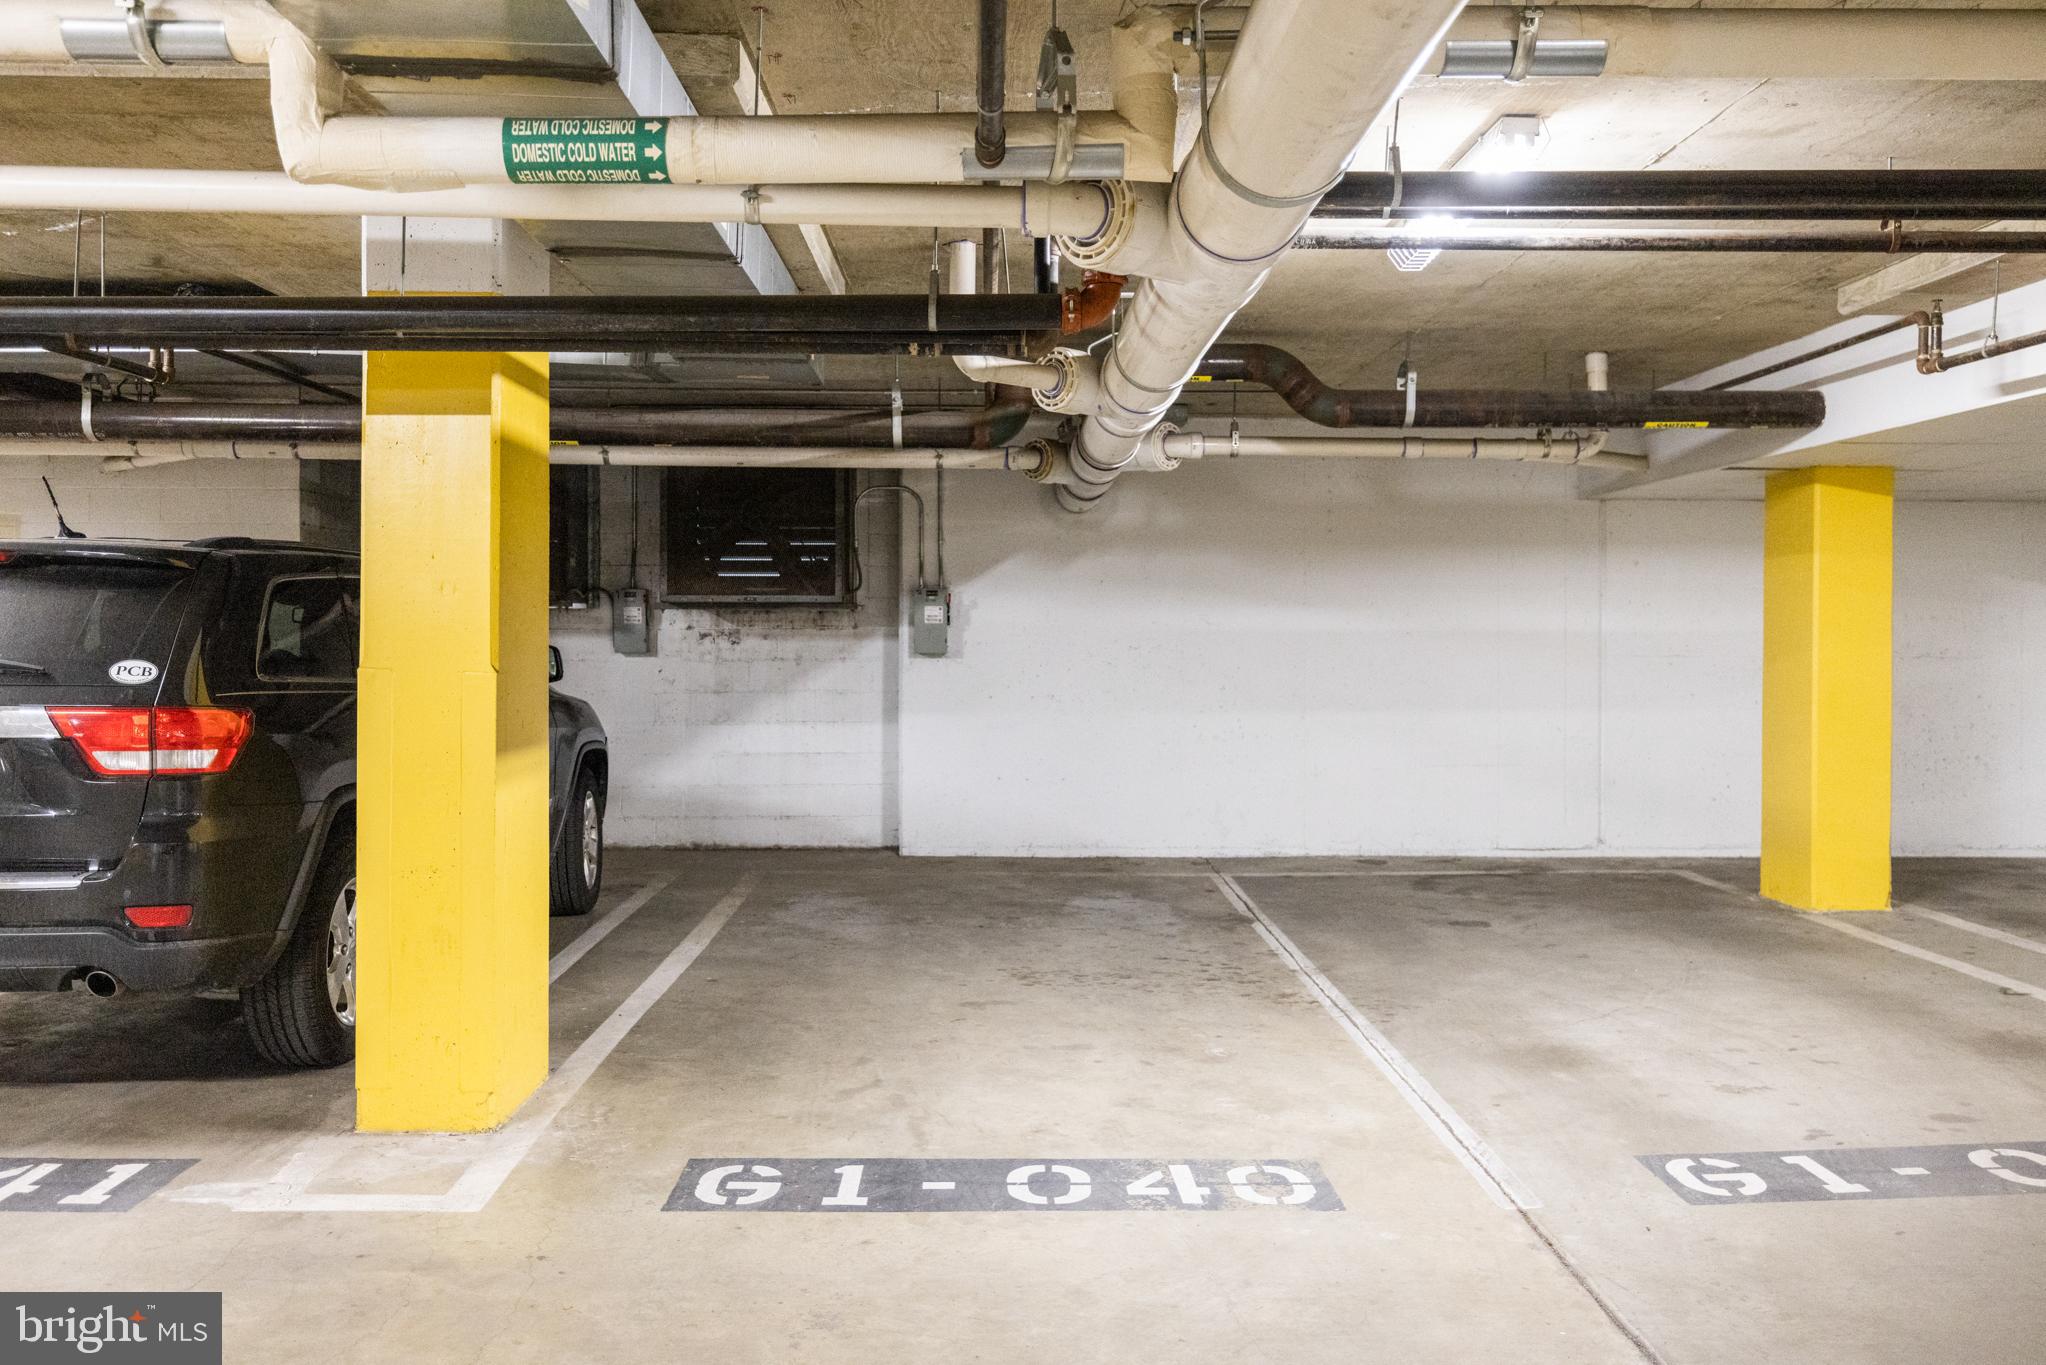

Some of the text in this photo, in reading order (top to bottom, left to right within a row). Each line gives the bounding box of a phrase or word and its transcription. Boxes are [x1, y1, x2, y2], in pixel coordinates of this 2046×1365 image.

[511, 120, 636, 136] DOMESTIC COLD WATER
[511, 143, 637, 163] DOMESTIC COLD WATER
[516, 170, 641, 182] DOMESTIC COLD WATER
[115, 665, 153, 677] PCB
